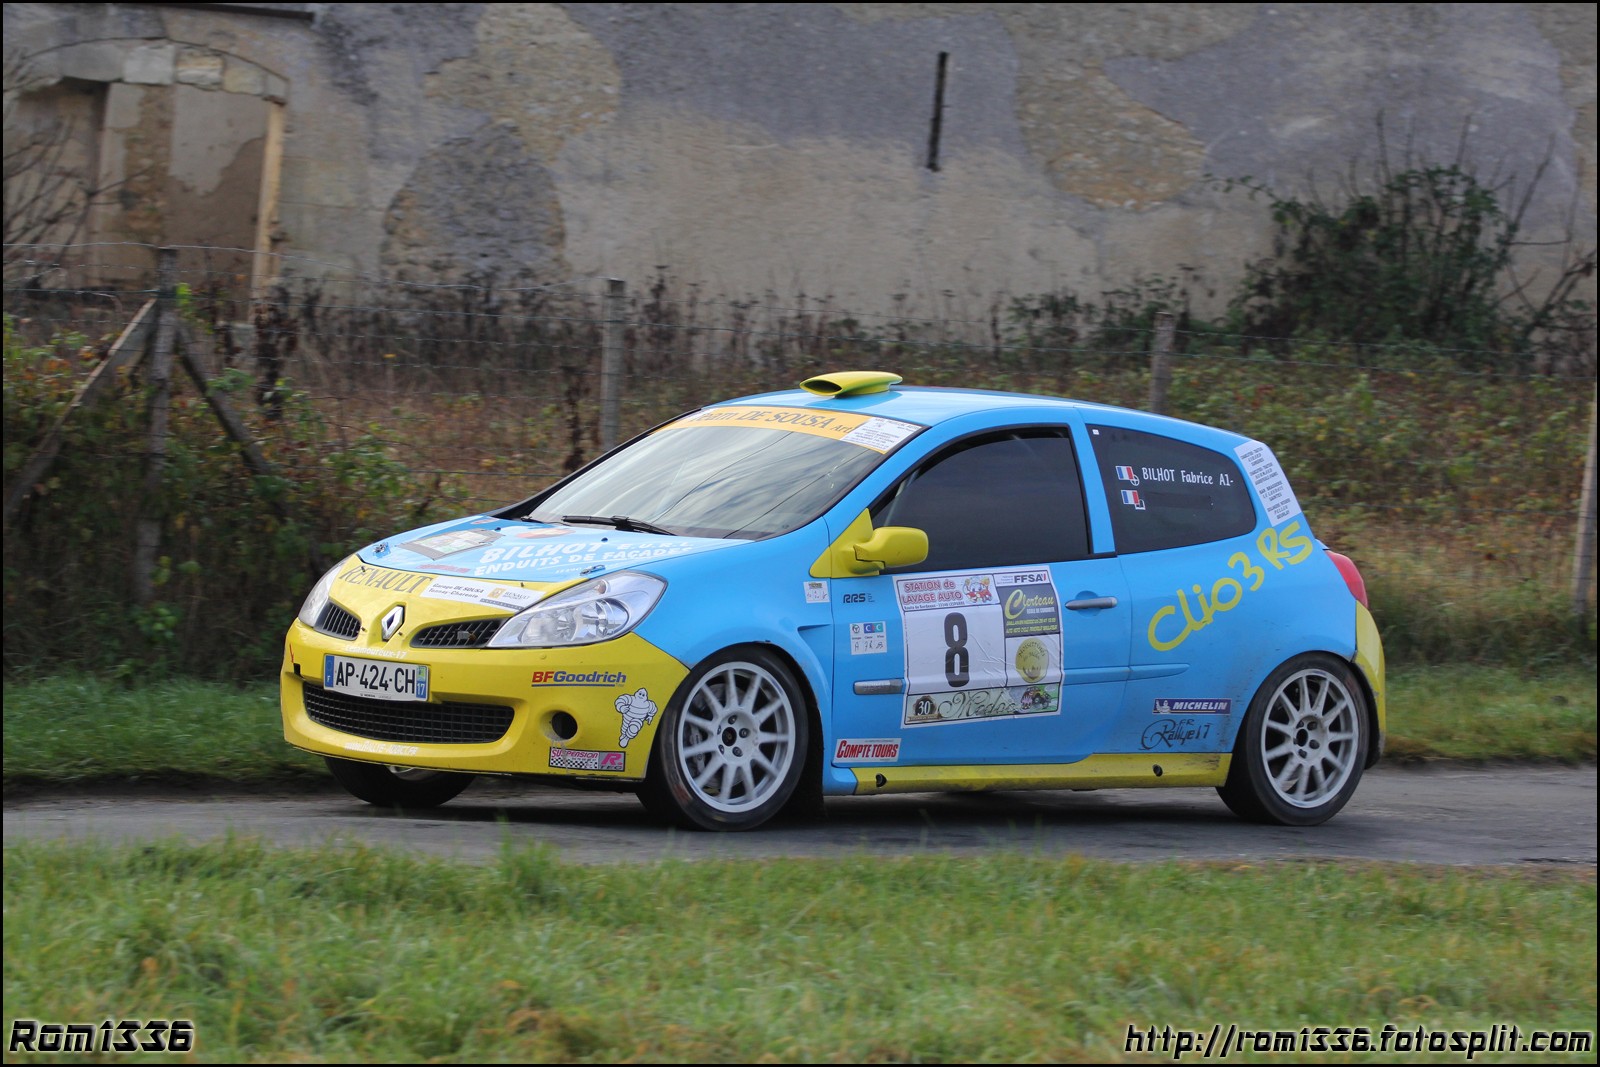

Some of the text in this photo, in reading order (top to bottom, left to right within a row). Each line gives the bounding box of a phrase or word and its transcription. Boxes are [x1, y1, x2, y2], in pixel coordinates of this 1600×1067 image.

[737, 410, 773, 421] DE
[766, 411, 836, 429] SOUSA
[1141, 467, 1175, 482] BILHOT
[1180, 469, 1214, 485] Fabrice
[479, 541, 602, 563] BILHOT
[1227, 551, 1265, 592] 3
[1256, 520, 1313, 570] RS
[473, 555, 561, 576] ENDUITS
[568, 553, 597, 563] DE
[339, 565, 434, 594] RENAULT
[904, 580, 956, 593] STATION de
[1014, 573, 1044, 583] FFSA
[843, 593, 866, 604] RRS
[902, 591, 963, 604] LAVAGE AUTO
[944, 612, 970, 688] 8
[532, 671, 627, 683] BFGoodrich
[416, 683, 426, 696] 17
[1172, 701, 1228, 710] MICHELIN
[836, 740, 899, 759] COMPTE TOURS
